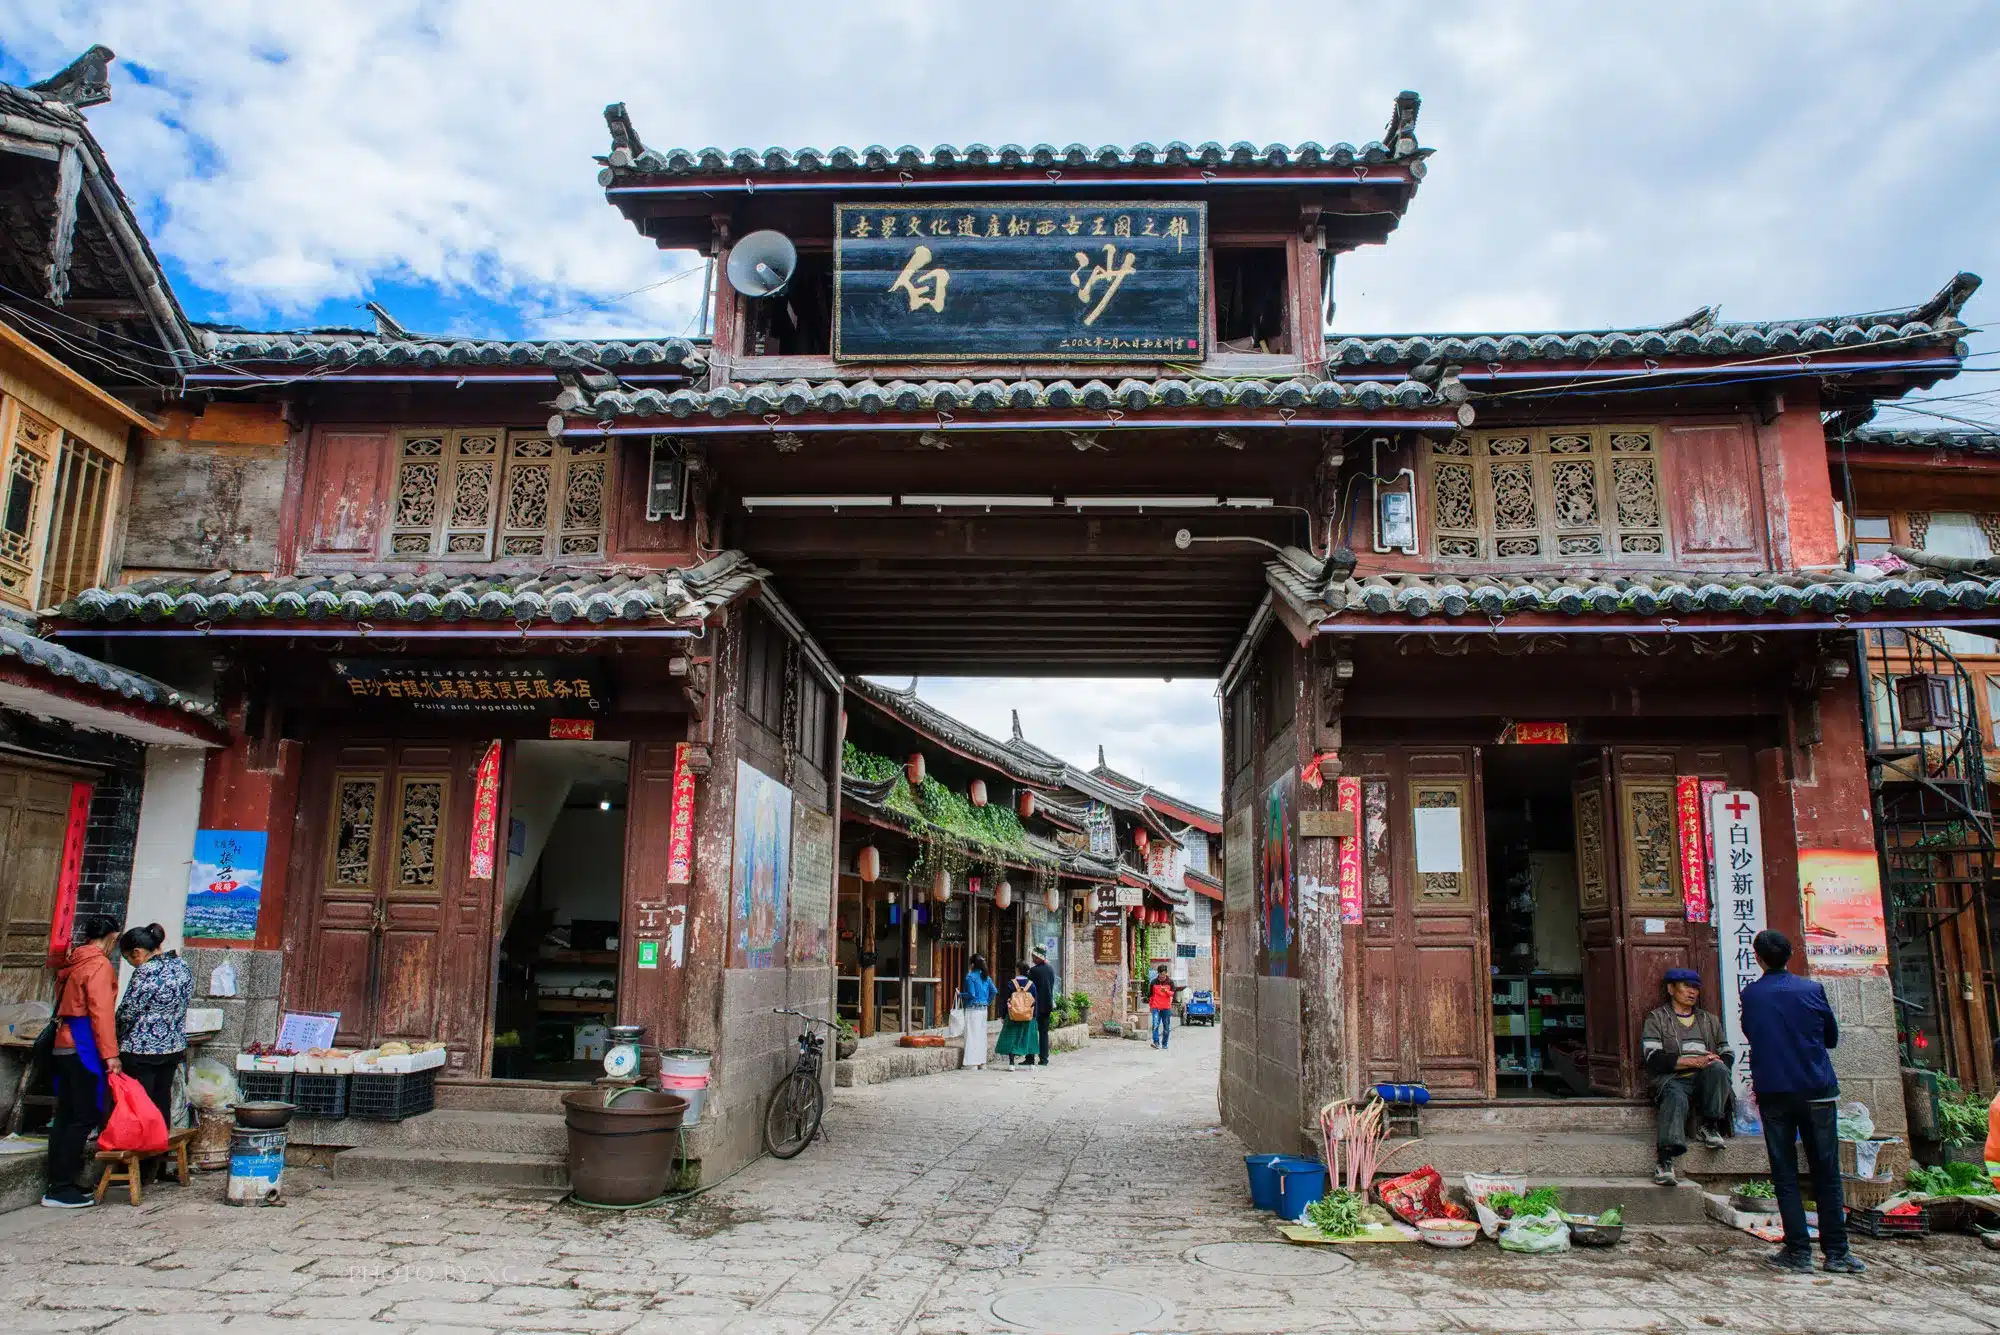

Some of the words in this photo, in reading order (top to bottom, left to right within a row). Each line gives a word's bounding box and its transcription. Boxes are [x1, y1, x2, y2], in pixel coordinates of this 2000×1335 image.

[888, 243, 1136, 326] 白沙
[347, 678, 592, 700] 白沙古镇水果蔬菜便民服务店
[413, 702, 446, 710] Fruits
[450, 703, 470, 711] and
[475, 703, 536, 712] vegetables
[1341, 784, 1358, 900] 四季安人财旺
